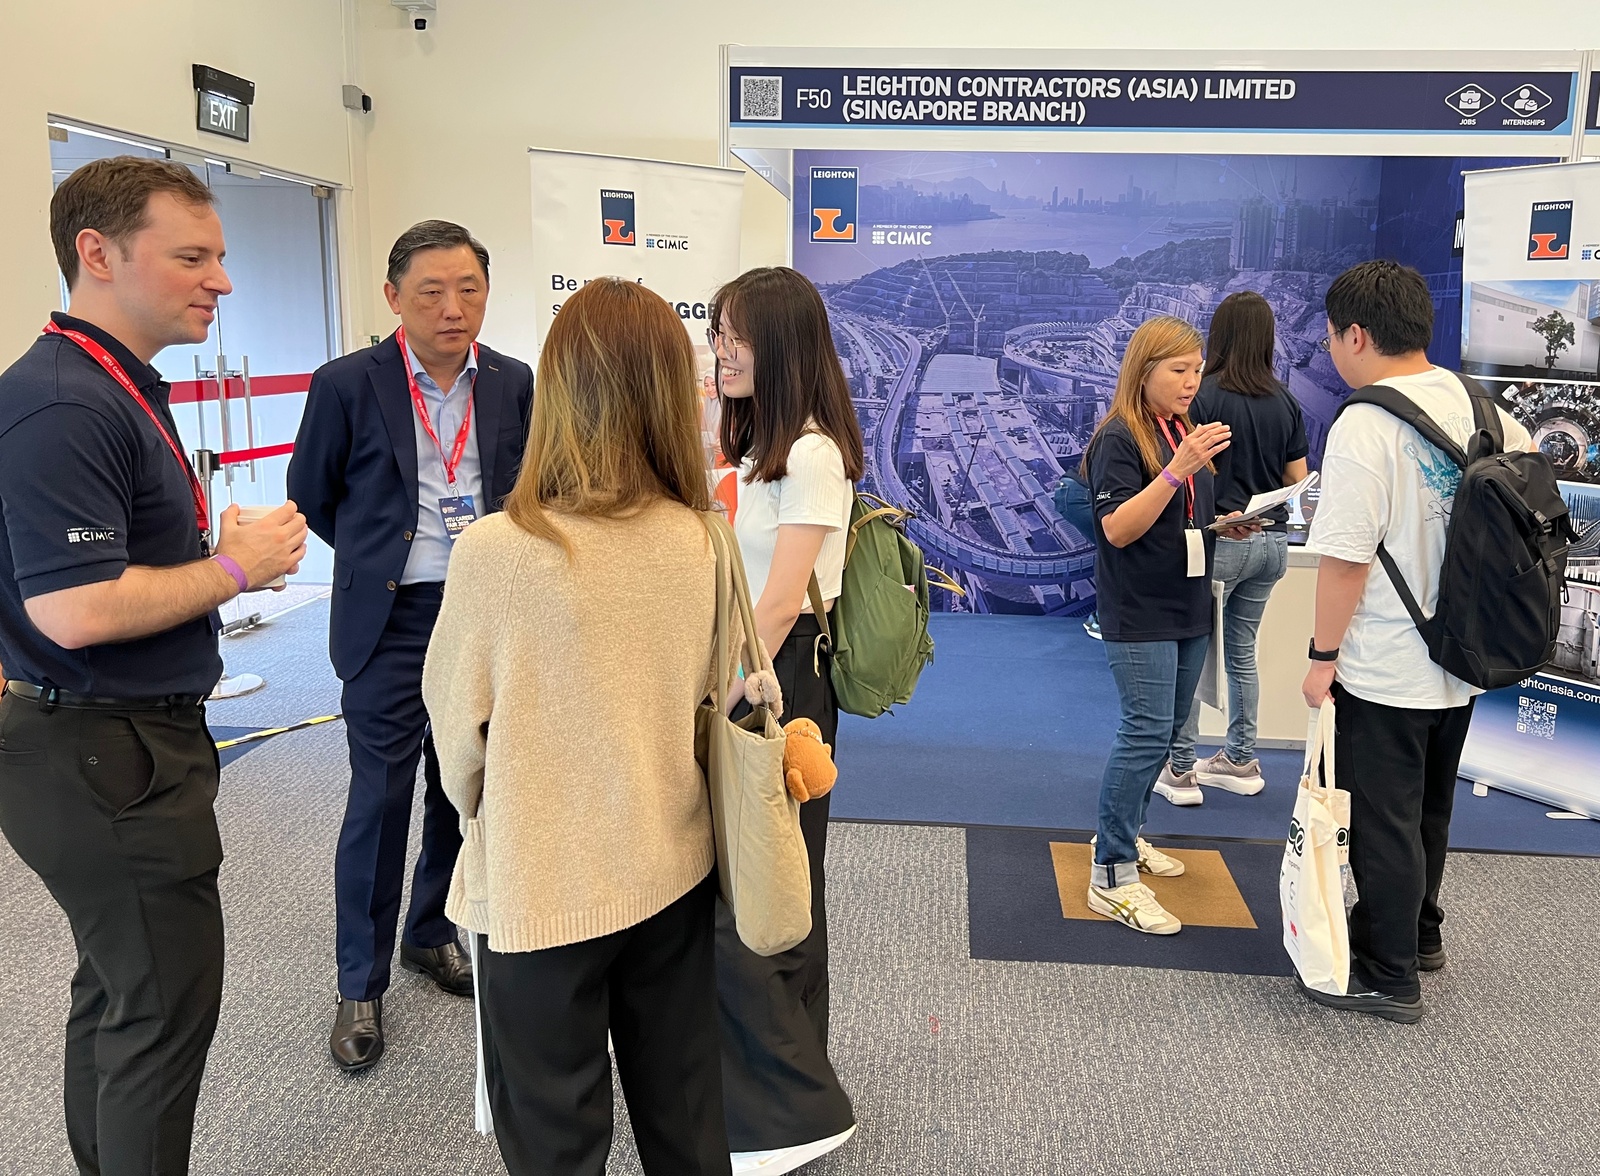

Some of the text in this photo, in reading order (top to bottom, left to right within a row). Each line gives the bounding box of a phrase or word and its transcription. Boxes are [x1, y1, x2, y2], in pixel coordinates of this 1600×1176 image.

[843, 75, 1296, 102] LEIGHTON CONTRACTORS (ASIA) LIMITED
[796, 88, 831, 109] F50
[210, 100, 238, 131] EXIT
[842, 99, 1086, 125] (SINGAPORE BRANCH)
[813, 171, 855, 179] LEIGHTON
[602, 191, 634, 200] LEIGHTON
[1534, 203, 1571, 211] LEIGHTON
[656, 239, 689, 250] CIMIC
[886, 231, 932, 245] CIMIC
[551, 275, 578, 291] Be
[81, 532, 115, 542] CIMIC
